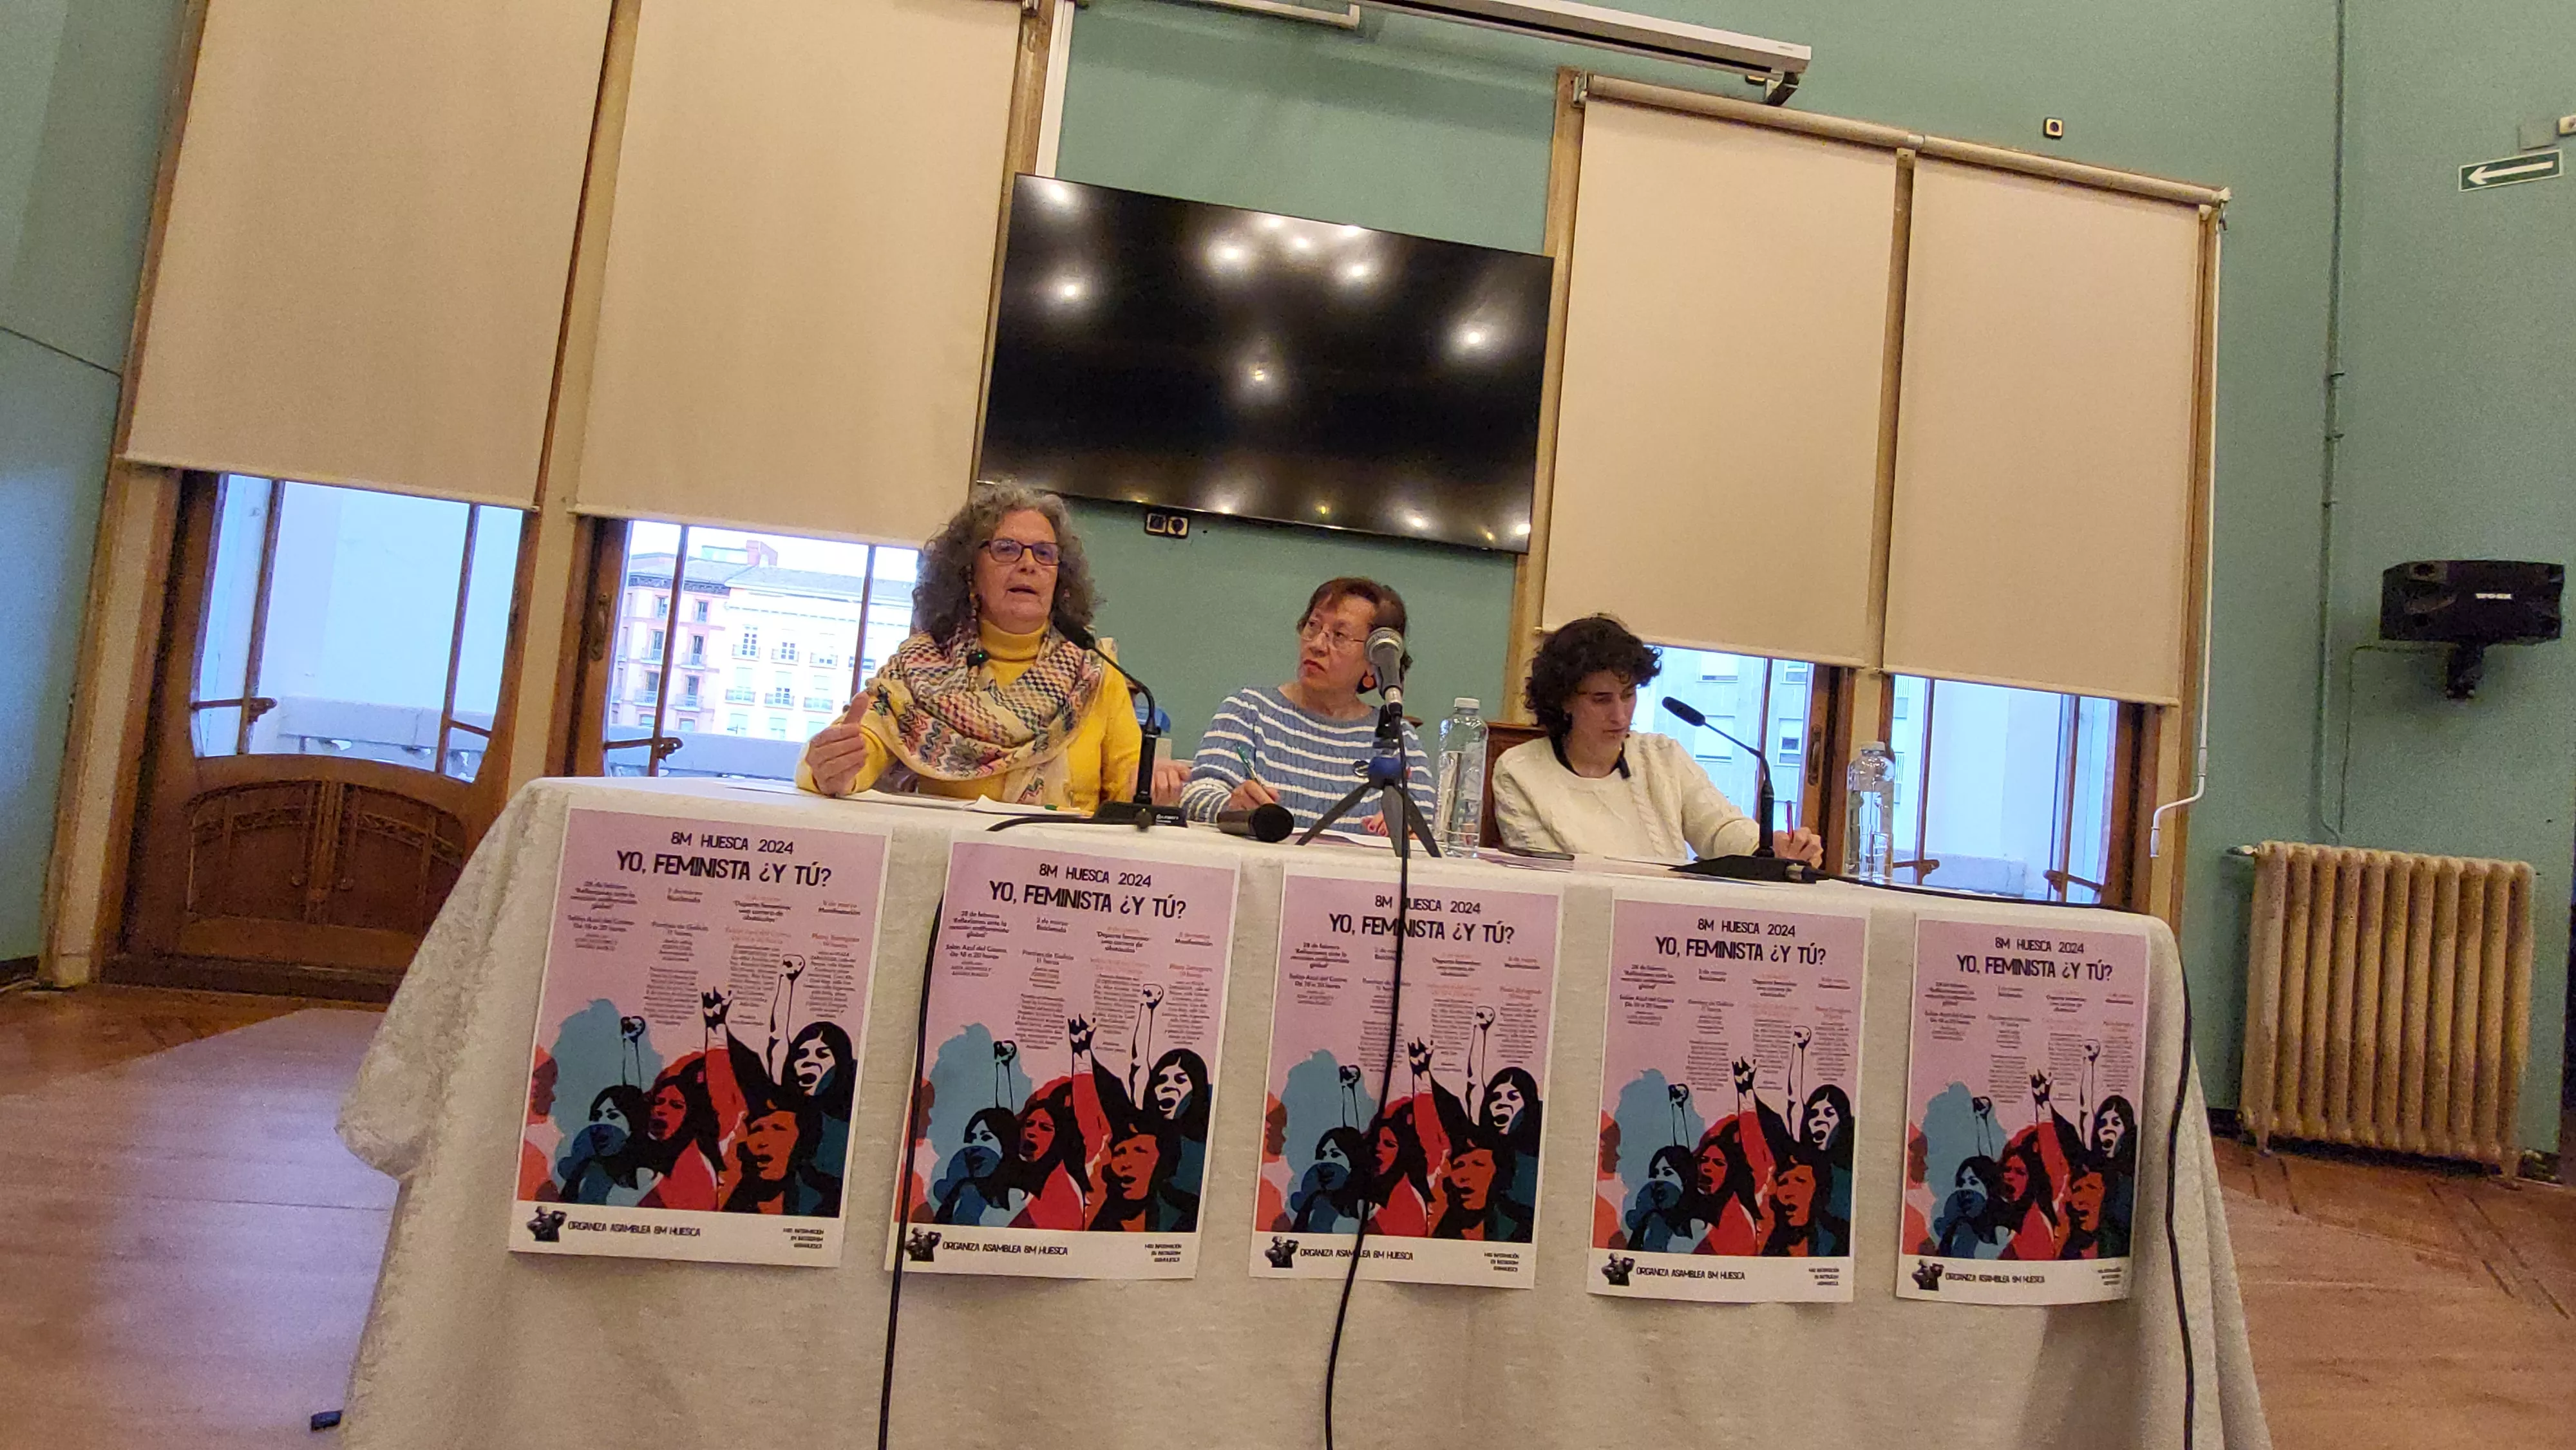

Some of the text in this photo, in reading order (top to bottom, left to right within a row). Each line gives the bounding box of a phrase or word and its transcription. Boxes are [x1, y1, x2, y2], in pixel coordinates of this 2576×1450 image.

[670, 831, 793, 854] 8M HUESCA 2024
[617, 851, 831, 887] YO, FEMINISTA ¿Y TÚ?
[1039, 863, 1151, 888] 8M HUESCA 2024
[989, 881, 1186, 919] YO, FEMINISTA ¿Y TÚ?
[1375, 895, 1481, 914] 8M UESCA 2024
[1329, 913, 1514, 945] YO, FEMNISTA ¿Y TÚ?
[1698, 918, 1795, 937] 8M HUESCA 2024
[1655, 936, 1826, 965] YO, FEMINISTA ¿Y TÚ?
[1995, 937, 2084, 954] 8M HUESCA 2024
[1956, 954, 2112, 981] YO, FEMINISTA ¿Y TÚ?
[568, 1221, 606, 1232] ORGANIZA
[610, 1221, 650, 1234] ASAMBLEA
[669, 1227, 701, 1237] HUESCA
[943, 1241, 980, 1252] ORGANIZA
[982, 1243, 1021, 1253] ASAMBLEA
[1038, 1245, 1068, 1256] HUESCA
[1300, 1248, 1333, 1257] ORGANIZA
[1387, 1251, 1414, 1261] HUESCA
[1636, 1266, 1669, 1276] ORGANIZA
[1720, 1271, 1745, 1280] HUESCA
